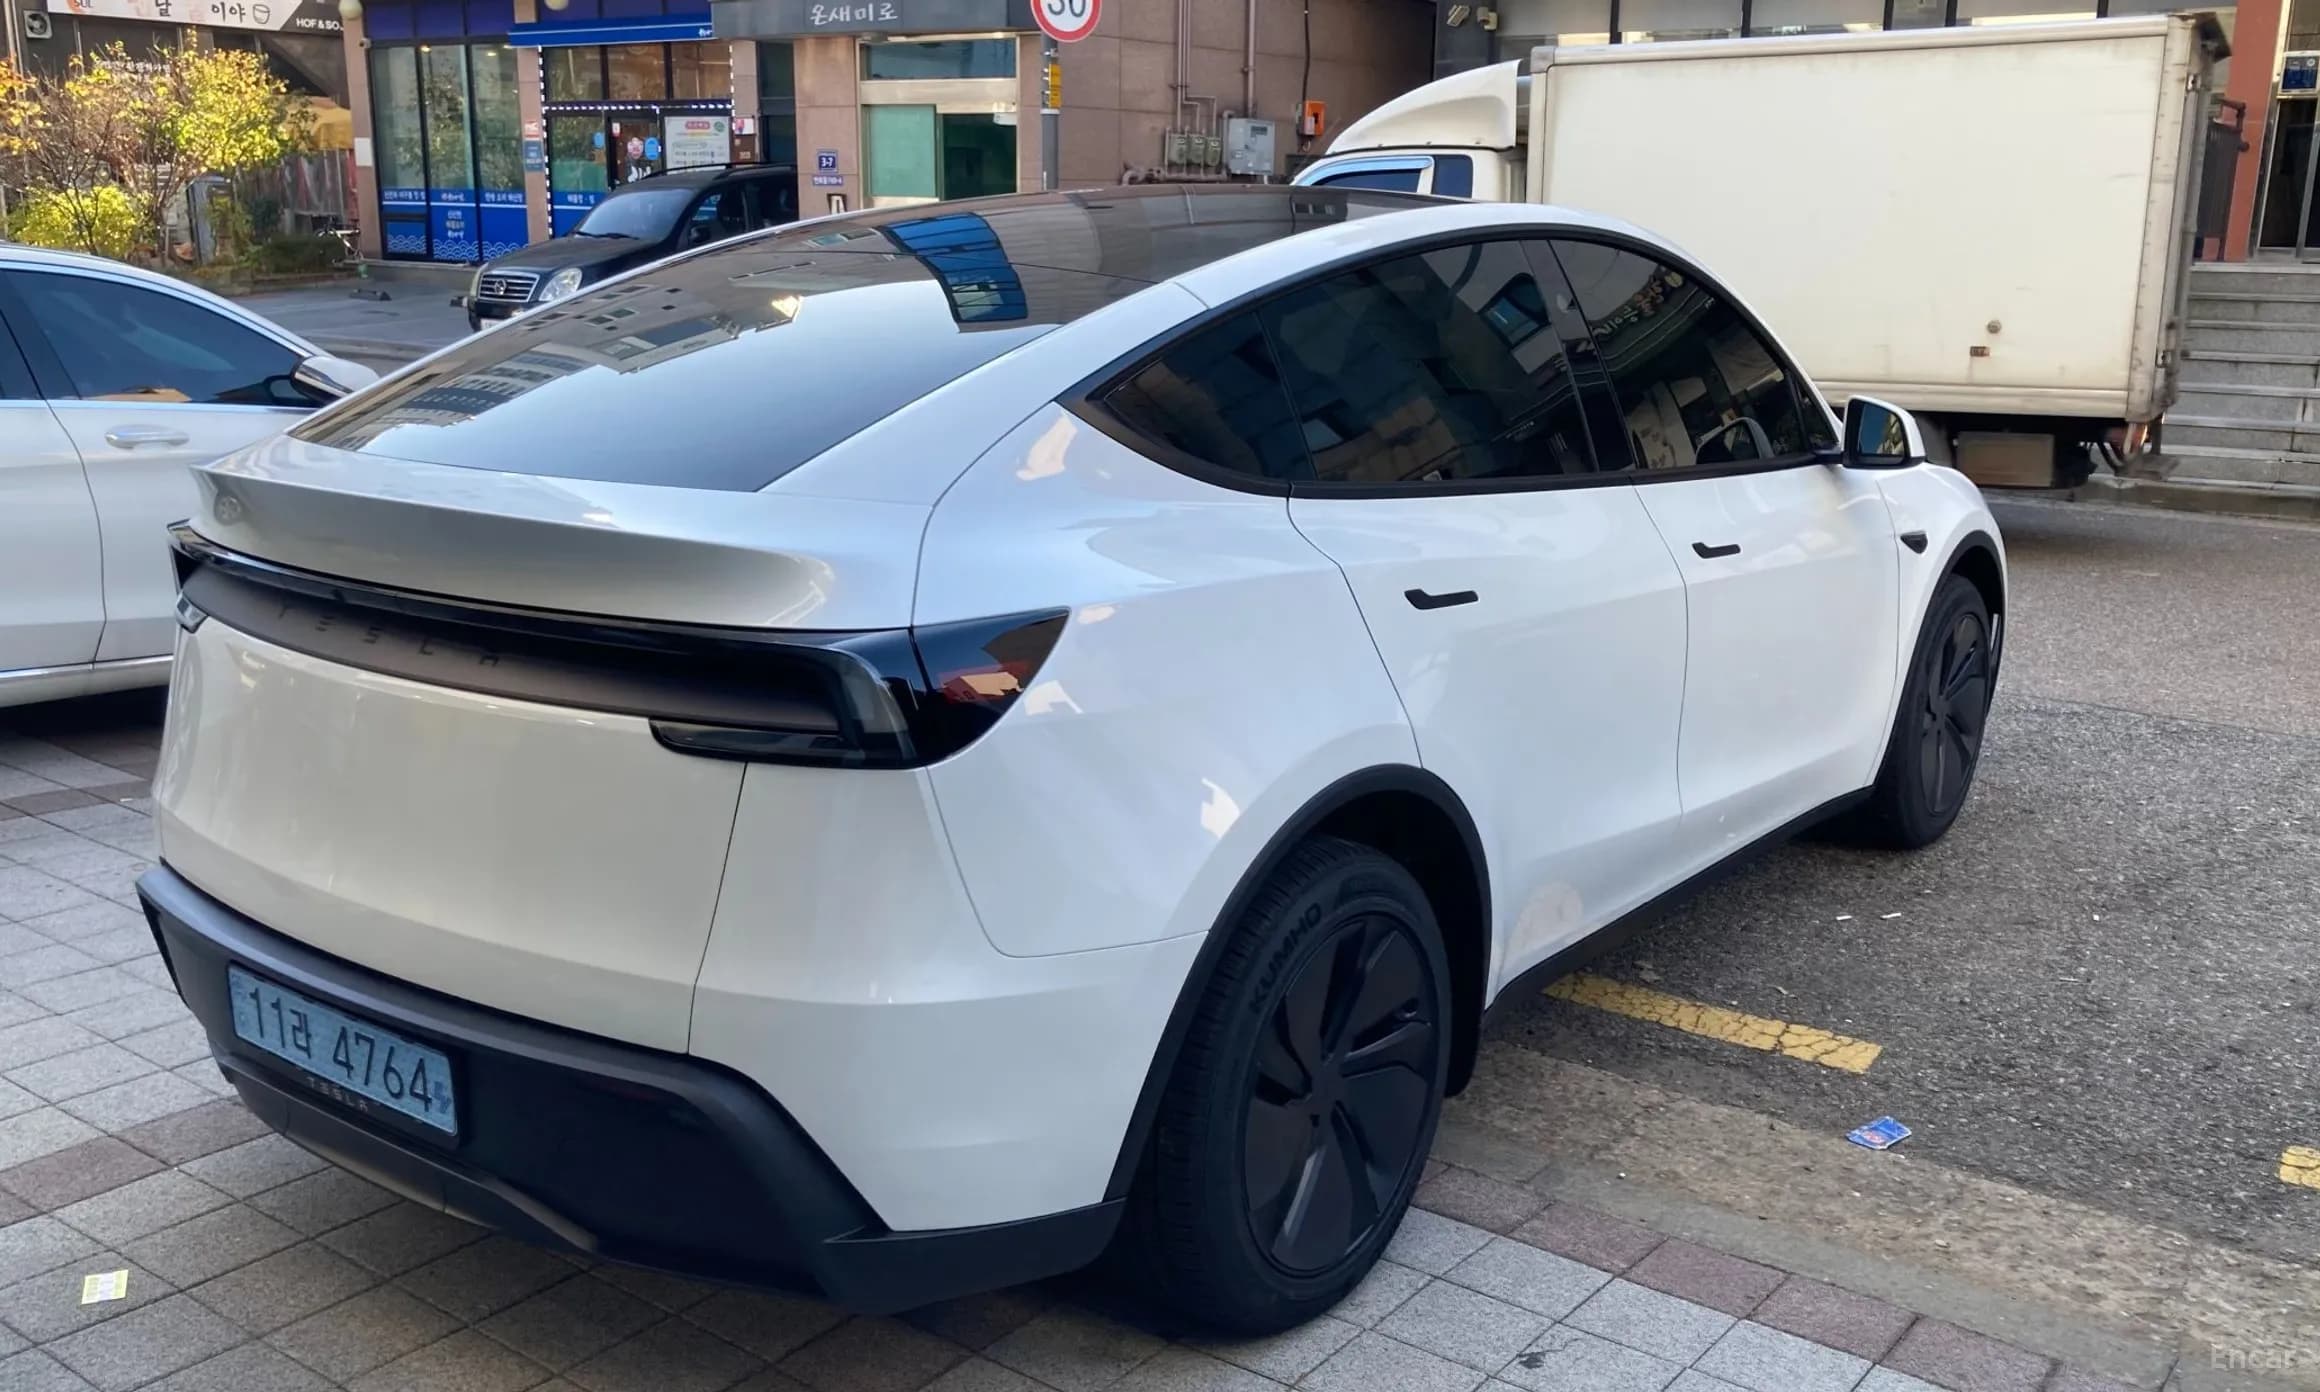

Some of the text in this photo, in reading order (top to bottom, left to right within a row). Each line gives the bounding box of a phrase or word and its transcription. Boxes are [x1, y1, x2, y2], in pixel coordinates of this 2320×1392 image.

[296, 18, 344, 31] HOF & SO
[810, 3, 898, 25] 온새미로
[278, 604, 499, 668] TESLA
[1248, 902, 1322, 1014] KUMHO
[249, 987, 313, 1059] 11라
[333, 1026, 433, 1112] 4764
[305, 1076, 369, 1112] TESLA
